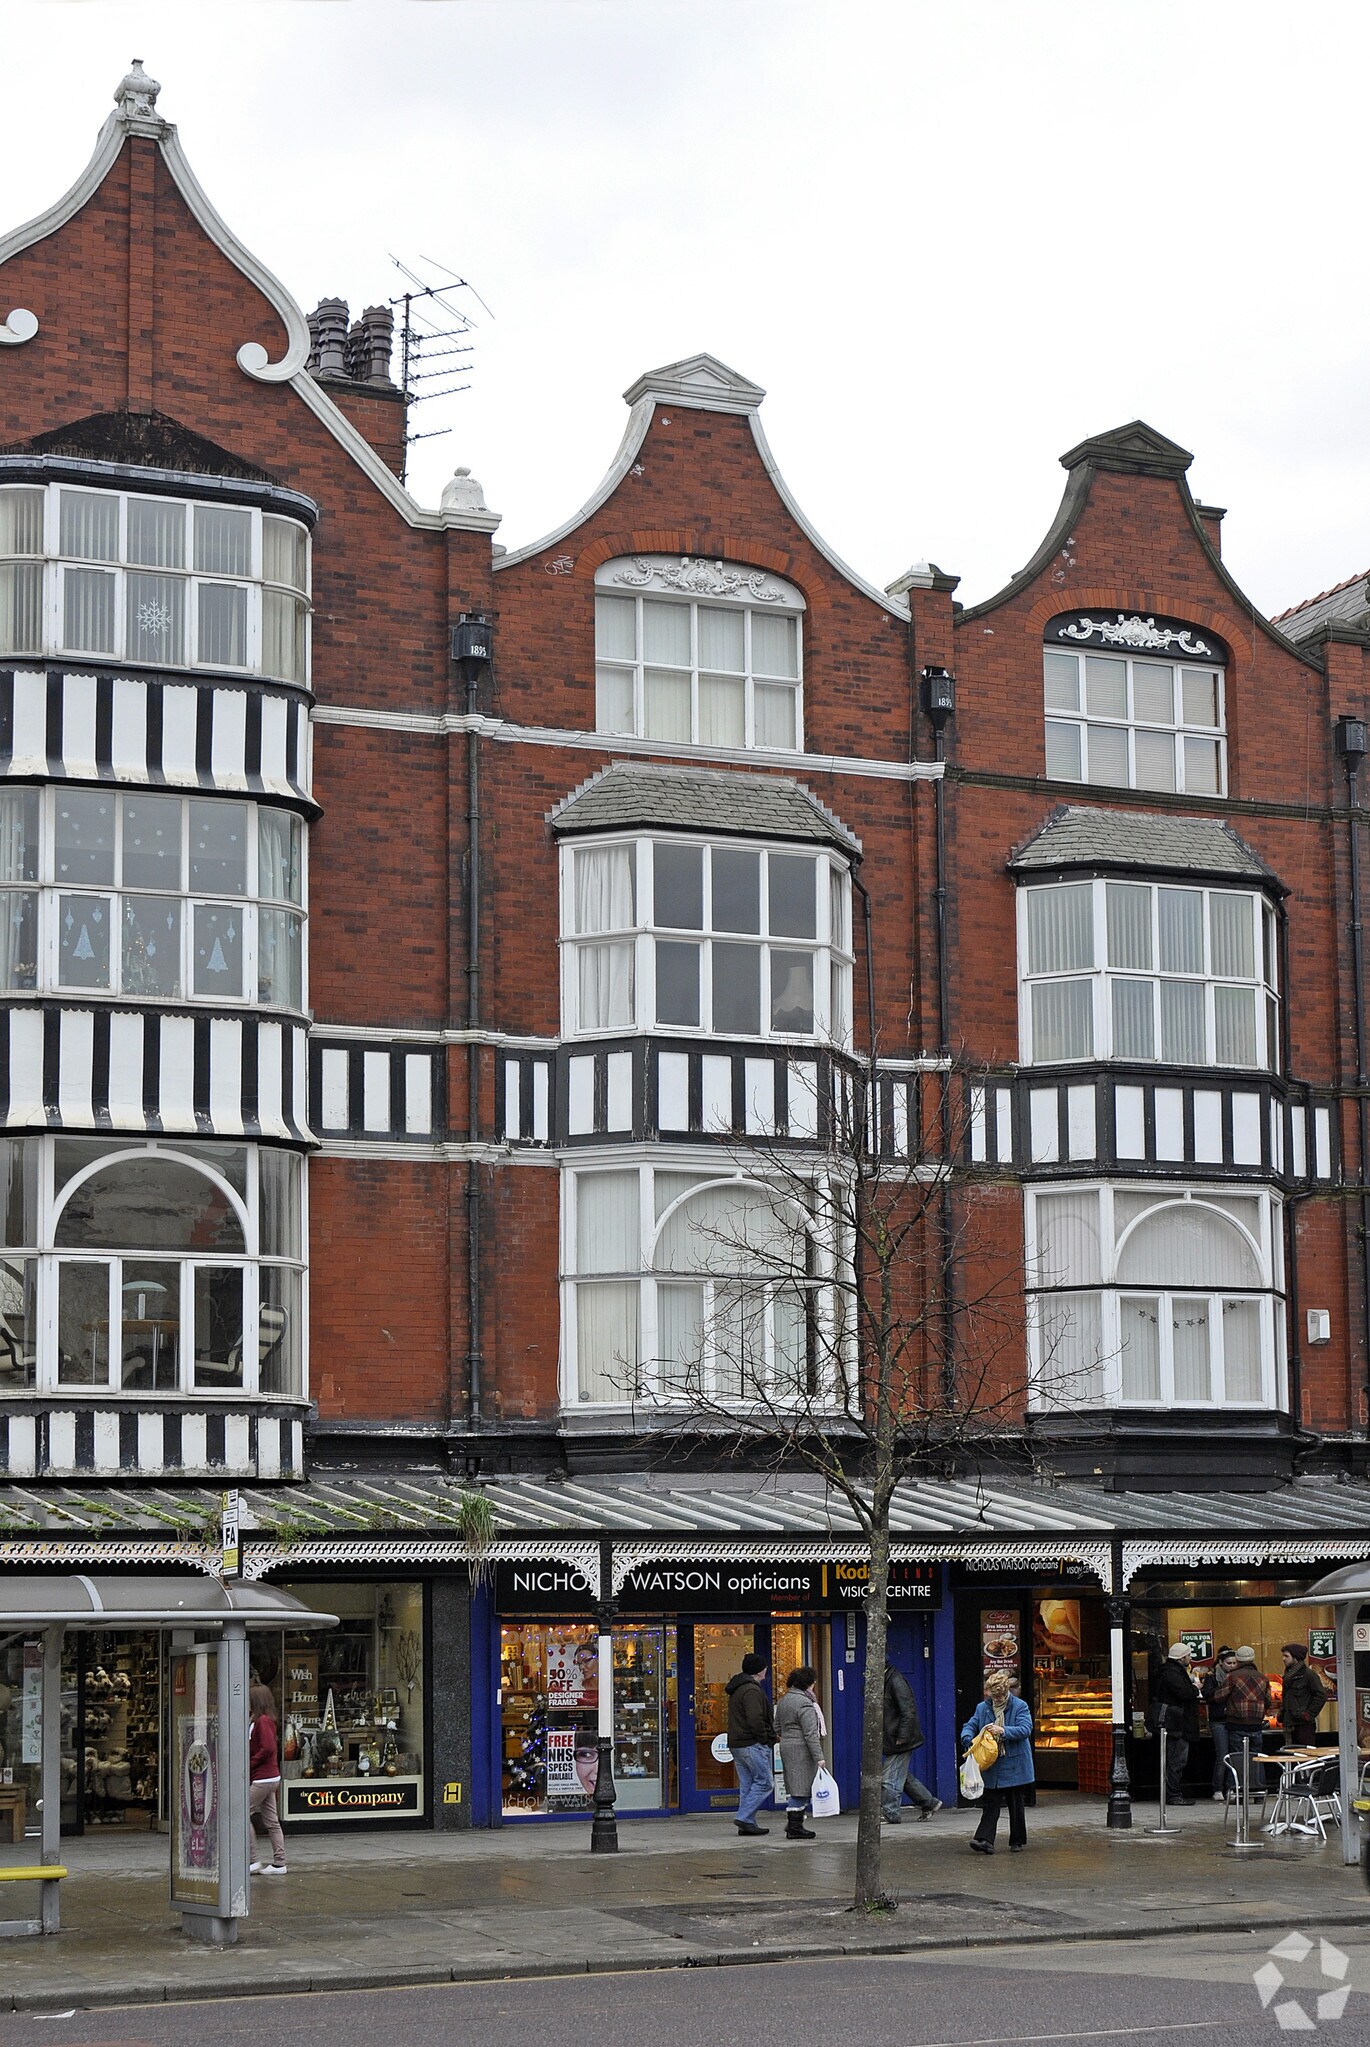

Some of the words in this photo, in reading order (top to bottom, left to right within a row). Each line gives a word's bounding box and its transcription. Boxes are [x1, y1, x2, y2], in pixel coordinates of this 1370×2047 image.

[225, 1526, 236, 1546] FA
[836, 1564, 870, 1580] Kod
[966, 1561, 999, 1572] NICHOLAS
[1000, 1560, 1030, 1571] WATSON
[1030, 1560, 1059, 1572] opticians
[514, 1572, 589, 1591] NICHO
[630, 1572, 720, 1591] WATSON
[727, 1572, 811, 1595] opticians
[770, 1593, 799, 1602] Member
[801, 1593, 811, 1602] of
[886, 1585, 931, 1598] CENTRE
[1312, 1639, 1334, 1655] £1
[291, 1668, 313, 1680] Wish
[549, 1669, 578, 1680] 50%
[549, 1680, 574, 1692] OFF
[291, 1691, 318, 1703] Home
[549, 1735, 574, 1748] FREE
[549, 1748, 574, 1762] NHS
[549, 1763, 574, 1773] SPECS
[549, 1773, 574, 1781] AVAILABLE
[308, 1791, 335, 1806] Gift
[338, 1790, 405, 1807] Company
[446, 1785, 459, 1801] H
[502, 1796, 557, 1808] ICHOLAS
